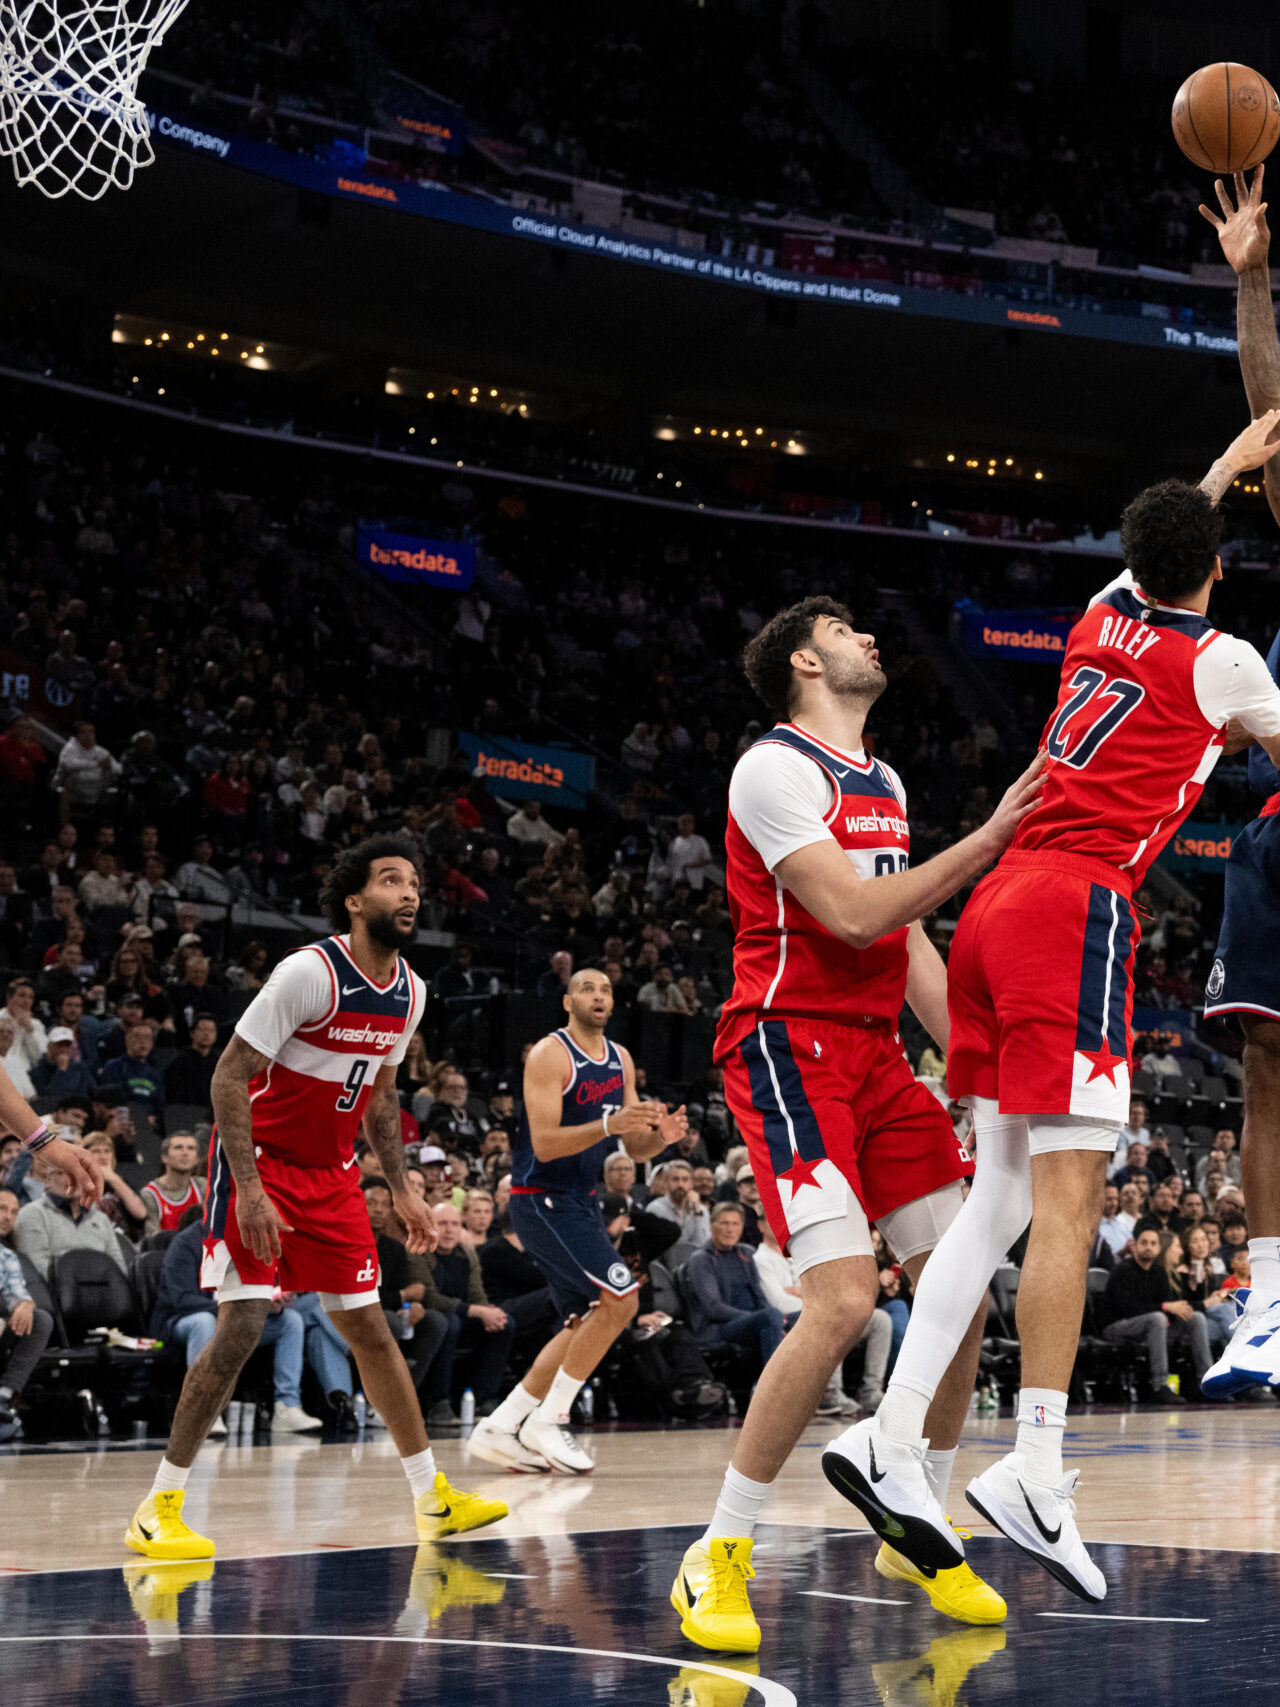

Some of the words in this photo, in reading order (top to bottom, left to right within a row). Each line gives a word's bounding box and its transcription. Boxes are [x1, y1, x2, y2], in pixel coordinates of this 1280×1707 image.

[158, 117, 231, 157] Company
[512, 216, 557, 239] Official
[558, 226, 596, 248] Cloud
[596, 236, 651, 259] Analytics
[652, 248, 696, 270] Partner
[697, 258, 712, 273] of
[713, 262, 733, 279] the
[734, 267, 752, 282] LA
[752, 271, 800, 293] Clippers
[803, 281, 829, 297] and
[830, 284, 862, 301] Intuit
[863, 288, 900, 307] Dome
[1163, 327, 1192, 346] The
[1193, 331, 1239, 352] Truste
[1097, 616, 1161, 660] RILEY
[1047, 666, 1146, 770] 27
[845, 806, 909, 839] washingto
[1174, 835, 1231, 858] terad
[335, 1059, 369, 1112] 9
[576, 1074, 624, 1105] Clippers
